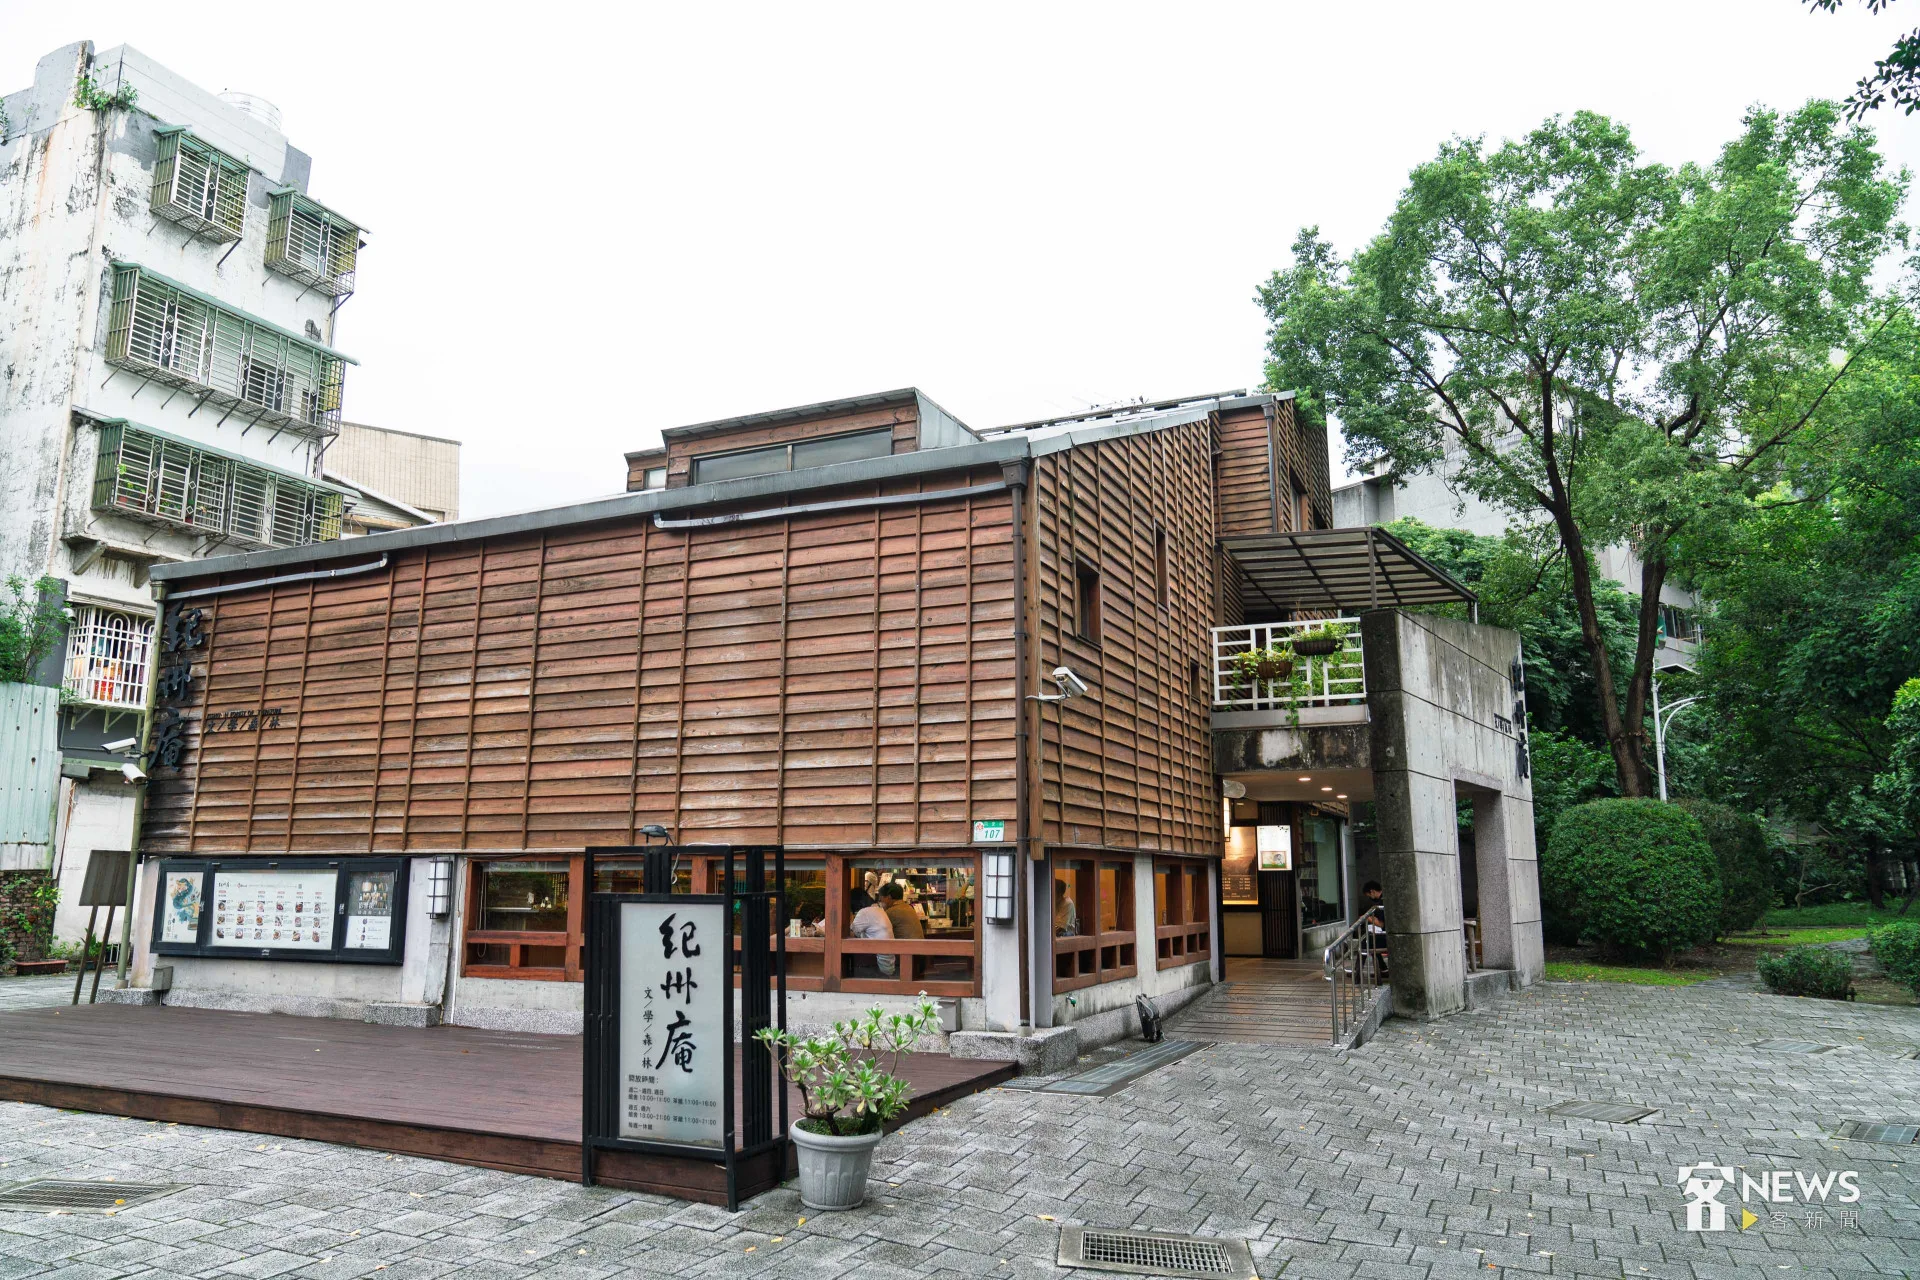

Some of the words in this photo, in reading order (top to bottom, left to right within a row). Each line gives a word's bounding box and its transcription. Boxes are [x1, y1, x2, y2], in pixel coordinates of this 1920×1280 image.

[985, 829, 1000, 839] 107
[655, 912, 701, 1073] 紀州庵
